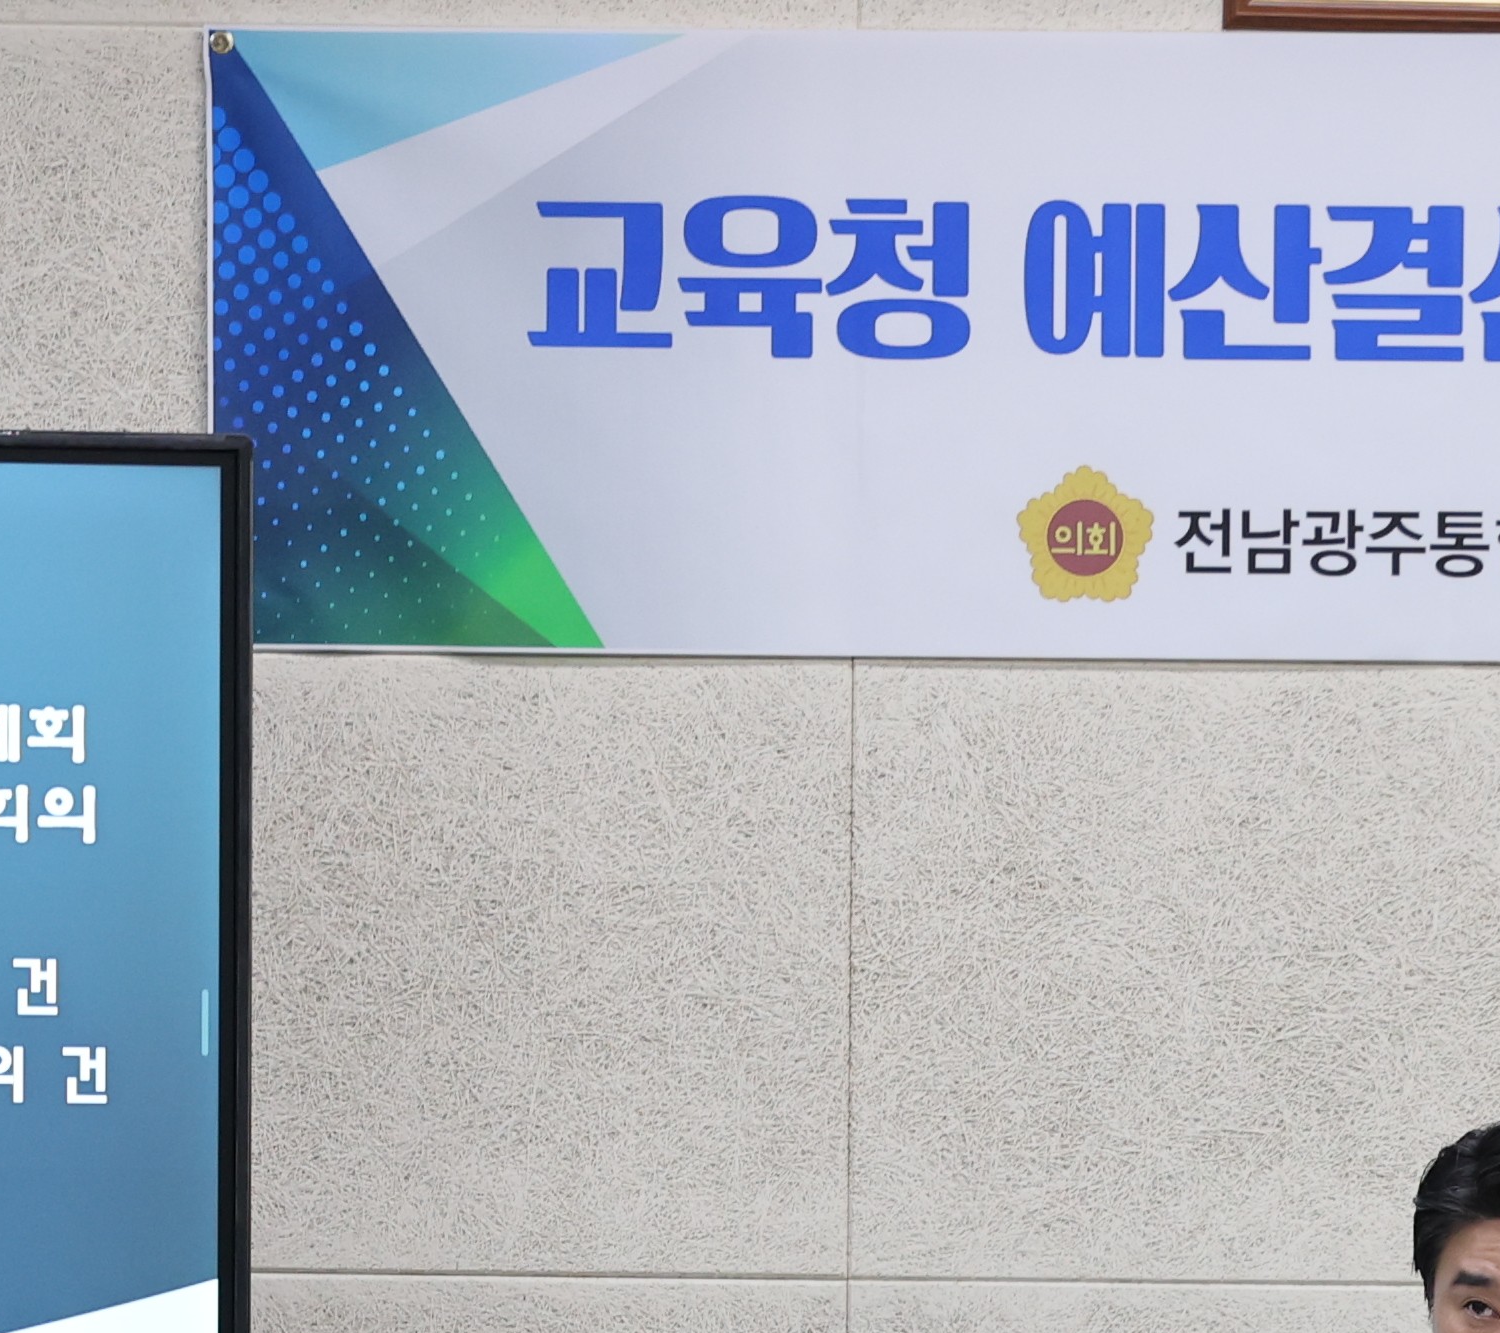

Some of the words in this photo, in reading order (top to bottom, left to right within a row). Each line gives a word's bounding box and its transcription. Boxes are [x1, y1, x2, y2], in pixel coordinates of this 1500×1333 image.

[529, 196, 971, 360] 교육청
[1050, 519, 1117, 557] 의회
[12, 958, 60, 1018] 건
[62, 1047, 109, 1106] 건
